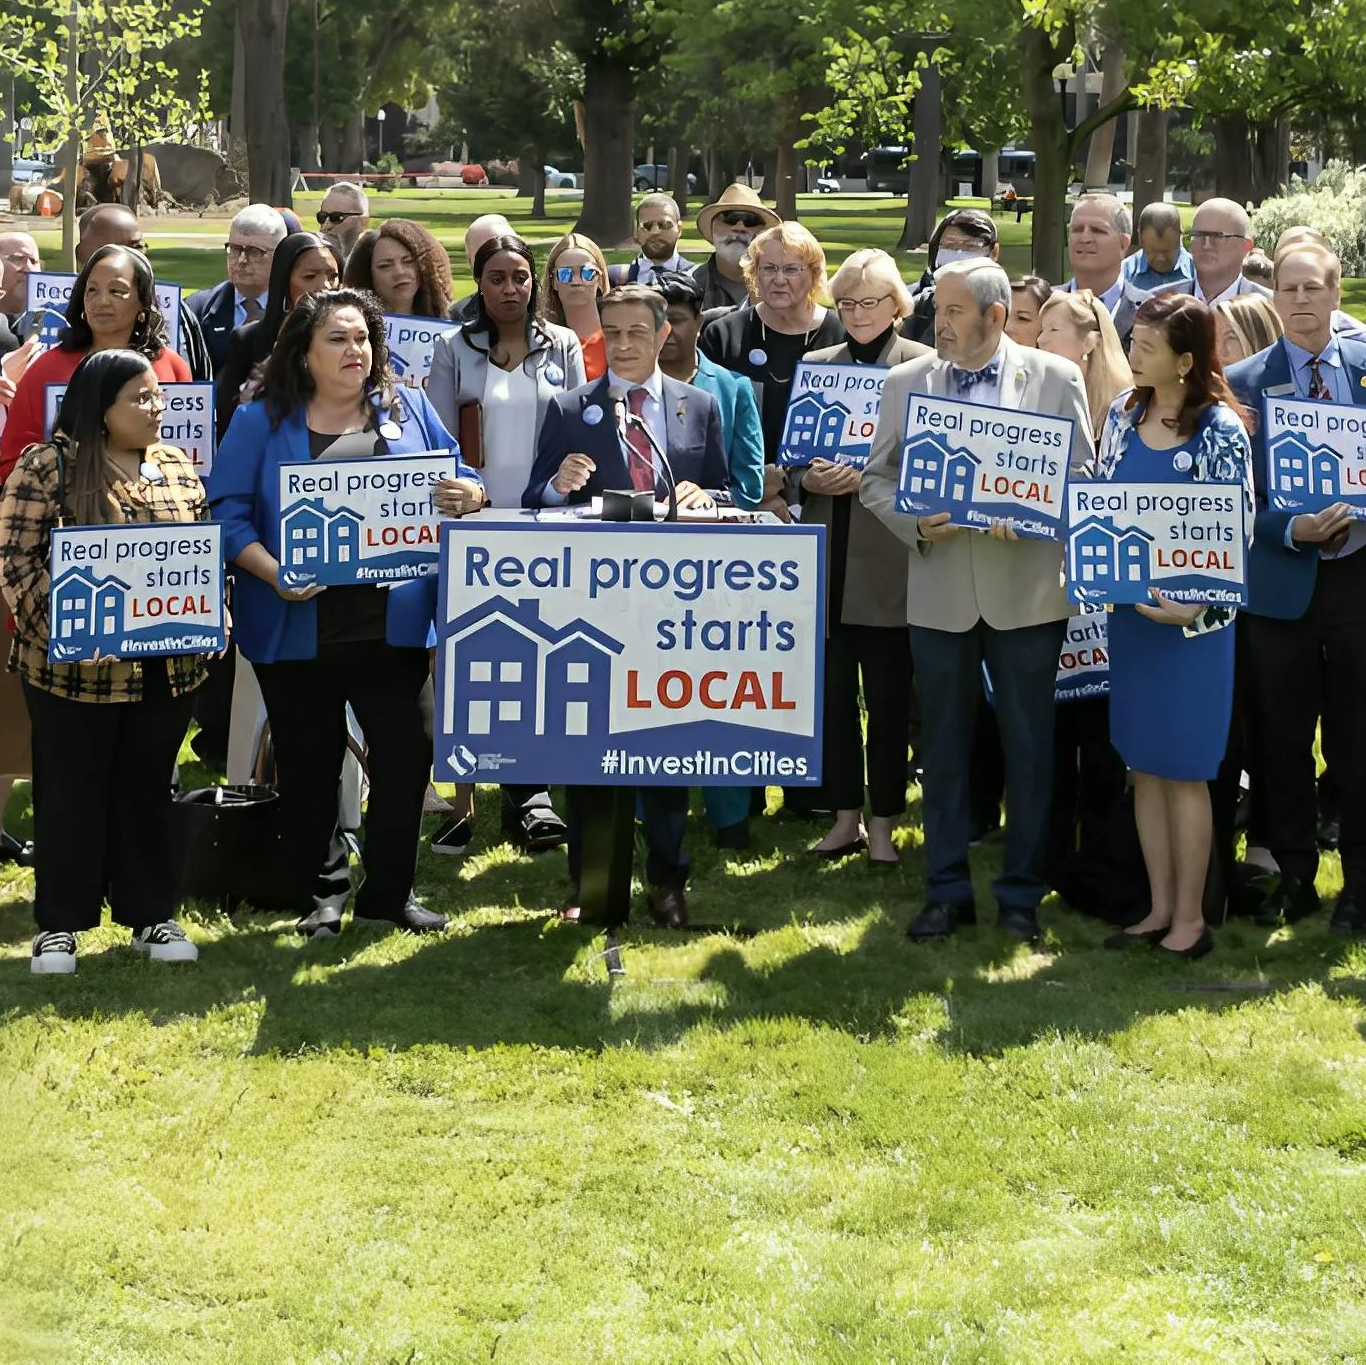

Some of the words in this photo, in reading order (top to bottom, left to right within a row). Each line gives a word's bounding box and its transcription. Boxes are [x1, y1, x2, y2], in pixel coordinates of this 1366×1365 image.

[161, 419, 203, 439] arts
[916, 405, 963, 431] Real
[970, 419, 1062, 447] progress
[1275, 407, 1319, 429] Real
[995, 450, 1059, 476] starts
[288, 470, 338, 493] Real
[980, 473, 1053, 504] LOCAL
[380, 492, 435, 517] start
[1077, 491, 1127, 511] Real
[1136, 495, 1234, 515] progress
[1170, 521, 1233, 541] starts
[61, 538, 107, 561] Real
[116, 538, 212, 563] progress
[1157, 549, 1234, 570] LOCAL
[146, 565, 210, 587] starts
[465, 546, 571, 588] Real
[589, 556, 800, 601] progress
[132, 594, 211, 618] LOCAL
[656, 609, 795, 652] starts
[1060, 648, 1108, 670] OCA
[626, 670, 796, 710] LOCAL
[601, 748, 807, 776] #InvestInCities
